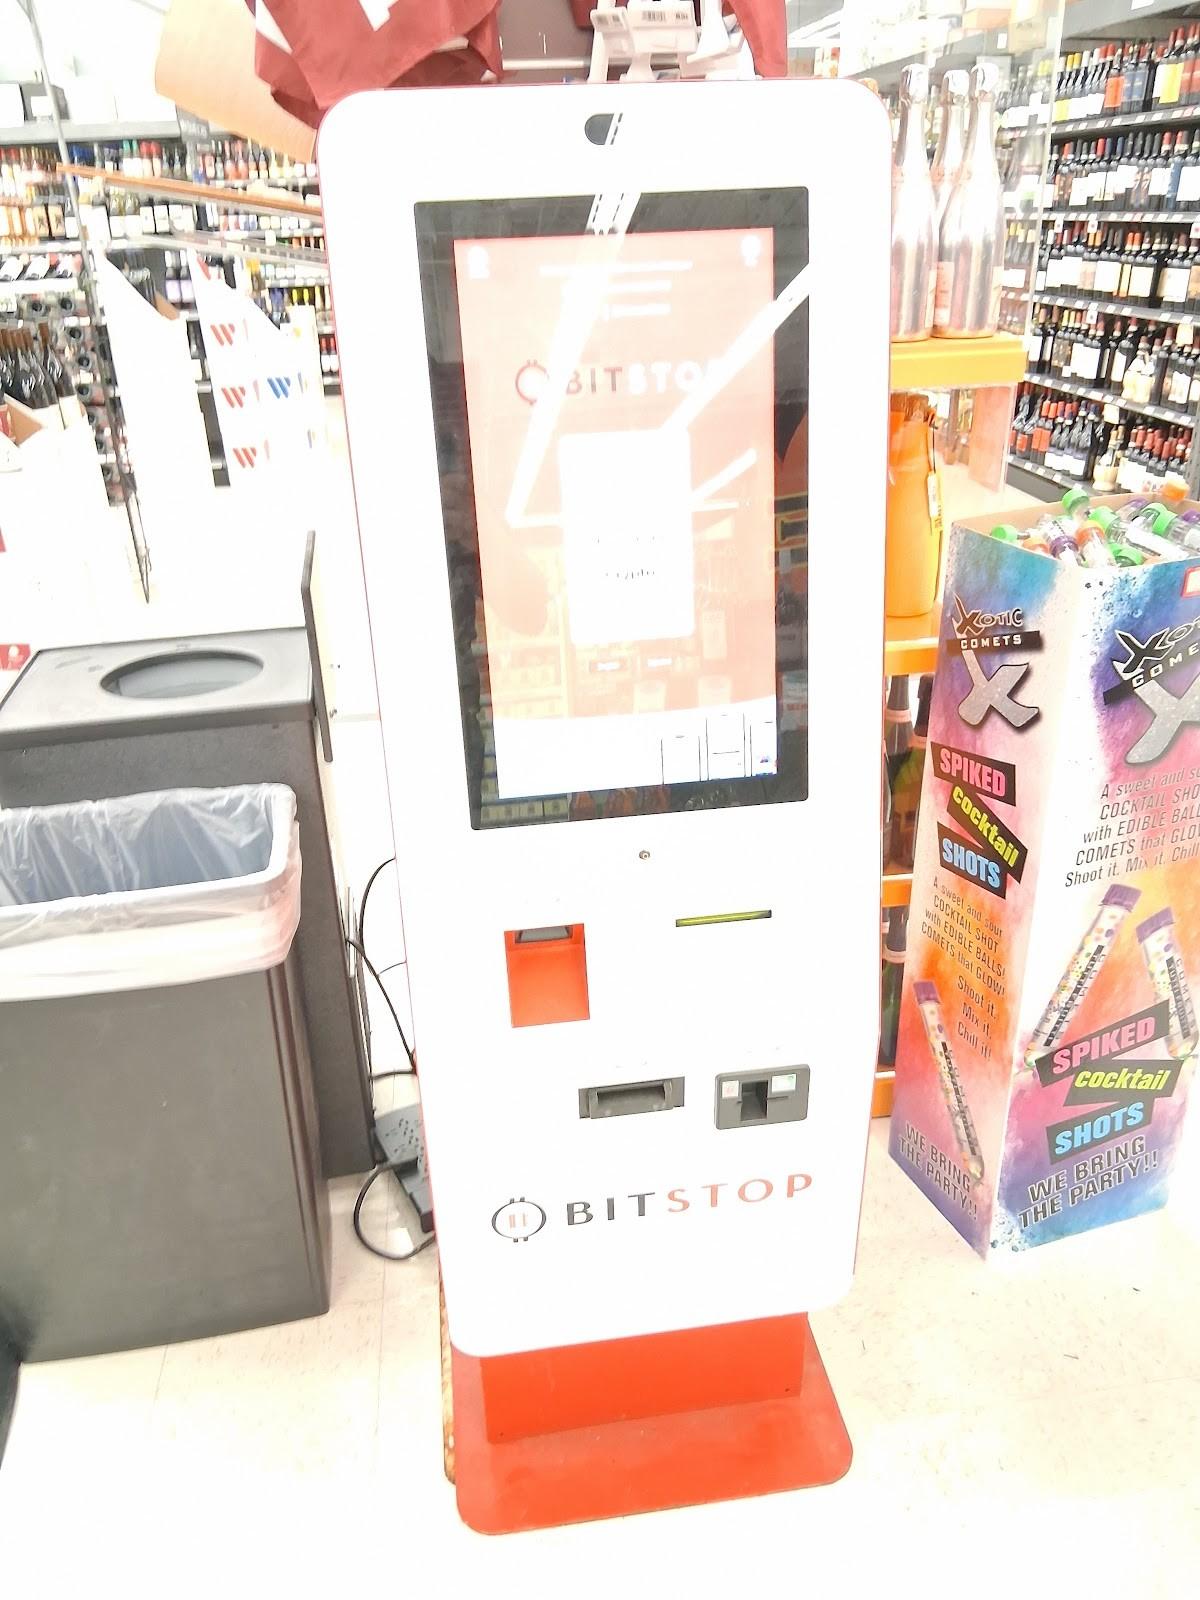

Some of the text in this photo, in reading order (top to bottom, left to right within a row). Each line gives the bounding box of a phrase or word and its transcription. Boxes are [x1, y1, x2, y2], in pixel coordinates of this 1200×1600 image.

[565, 360, 722, 395] BITSTO
[952, 591, 1023, 635] XOTIC
[960, 634, 1022, 650] COMETS
[939, 747, 1006, 797] SPIKED
[1100, 783, 1109, 799] A
[1116, 775, 1155, 796] sweet
[1160, 768, 1185, 786] and
[952, 785, 1019, 868] cocktail
[1083, 825, 1112, 844] with
[1117, 811, 1167, 836] EDIBLE
[1100, 792, 1165, 820] COCKTAIL
[942, 837, 1000, 889] SHOTS
[1065, 866, 1103, 887] Shoot
[1108, 862, 1120, 878] it.
[1126, 856, 1148, 873] Mix
[1075, 838, 1136, 866] COMETS
[1141, 832, 1166, 851] that
[933, 876, 1003, 937] A sweet and sour
[933, 895, 1000, 954] COCKTAIL SHOT
[921, 921, 1006, 996] COMETS that GLOW!
[925, 908, 1006, 978] with EDIBLE BALLS!
[957, 975, 984, 1008] Shoot
[962, 1002, 979, 1026] Mix
[957, 1021, 978, 1049] Chill
[1052, 1016, 1156, 1075] SPIKED
[1074, 1067, 1171, 1091] cocktail
[1054, 1101, 1144, 1156] SHOTS
[899, 1137, 978, 1220] THE PARTY!!
[906, 1123, 971, 1193] WE BRING
[1028, 1135, 1146, 1203] WE BRING
[566, 1173, 813, 1226] BITSTOP
[1017, 1149, 1159, 1229] THE PARTY!!
